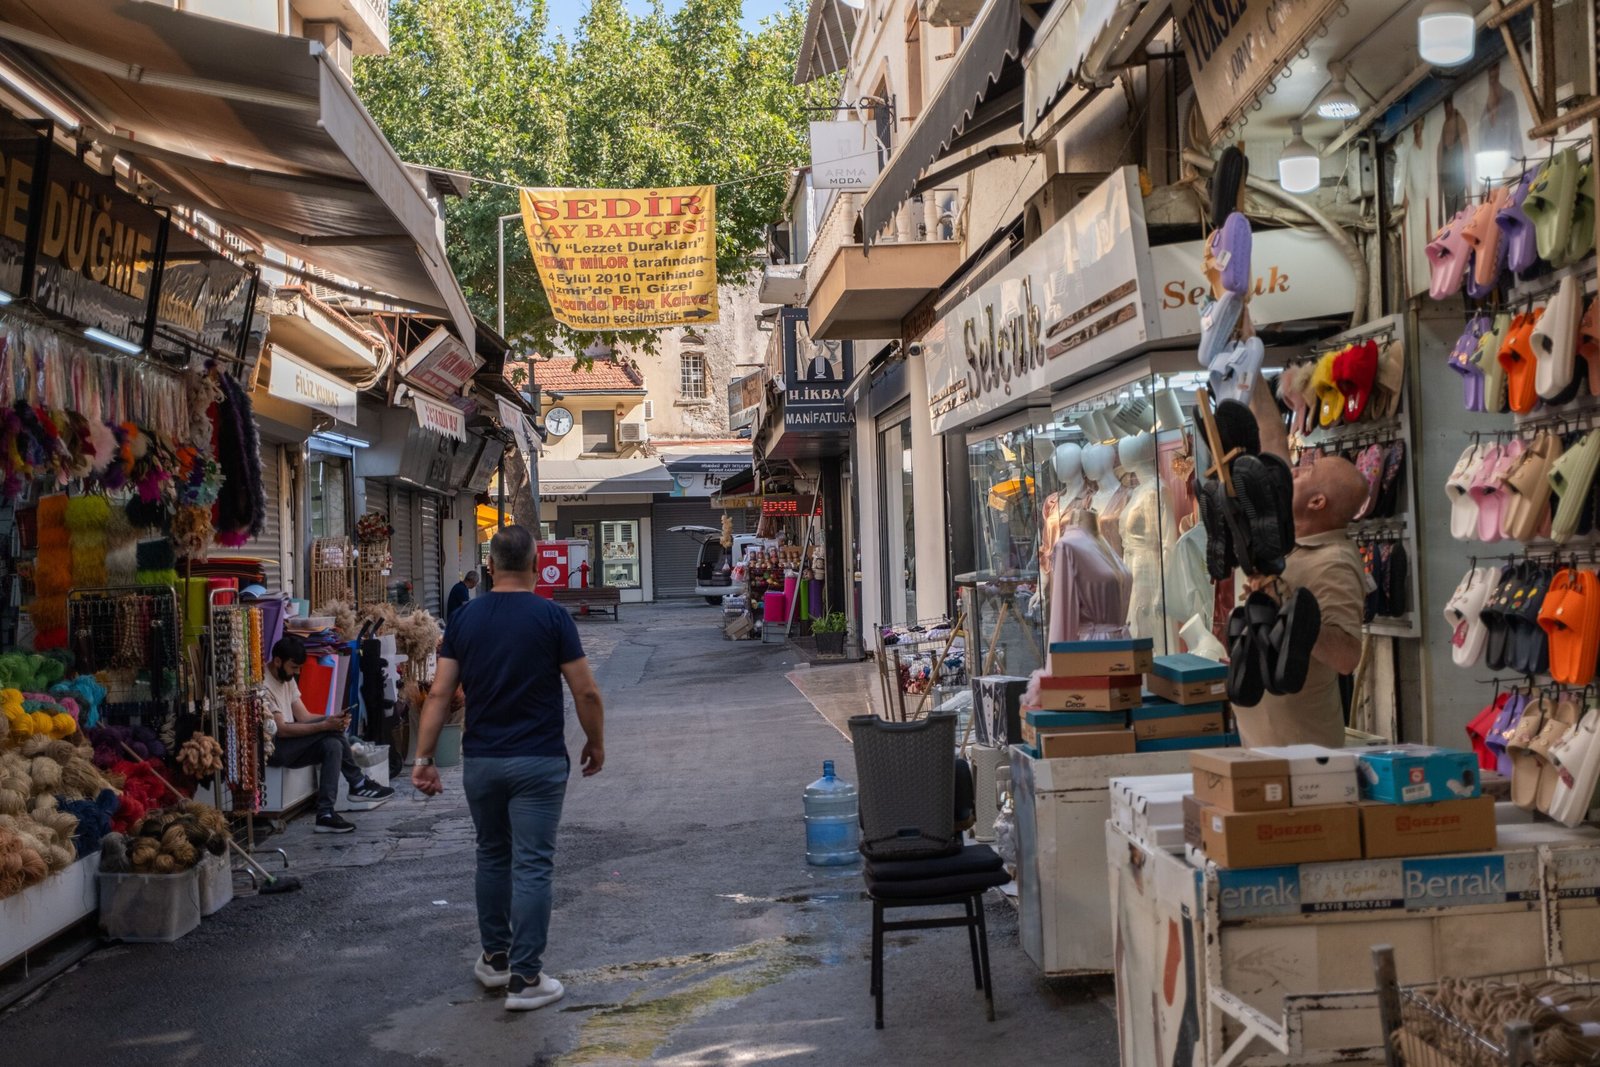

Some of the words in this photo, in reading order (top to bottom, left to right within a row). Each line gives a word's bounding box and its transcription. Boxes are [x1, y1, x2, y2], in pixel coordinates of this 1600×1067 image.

[825, 168, 866, 177] ARMA
[533, 191, 705, 220] SEDİR
[530, 223, 578, 240] ÇAY
[585, 216, 707, 239] BAHÇESİ
[42, 180, 152, 300] DÜĞME
[535, 241, 560, 253] NTV
[580, 254, 628, 269] MİLOR
[634, 255, 704, 268] tarafından
[556, 273, 591, 285] Eylül
[596, 273, 631, 283] 2010
[637, 269, 704, 282] Tarihinde
[619, 285, 640, 294] En
[647, 281, 692, 293] Güzel
[612, 295, 655, 314] Pişen
[568, 313, 610, 324] mekanı
[614, 310, 682, 323] seçilmiştir.
[963, 274, 1046, 400] Selçuk
[295, 369, 314, 398] FİLİZ
[789, 387, 846, 400] H.İKBA
[786, 411, 855, 425] MANİFATURA
[1412, 815, 1460, 828] GEZER
[1273, 824, 1322, 837] GEZER
[1302, 869, 1398, 881] COLLECTION
[1406, 866, 1502, 899] Berrak
[1314, 901, 1344, 911] SATIŞ
[1346, 900, 1391, 909] NOKTASI
